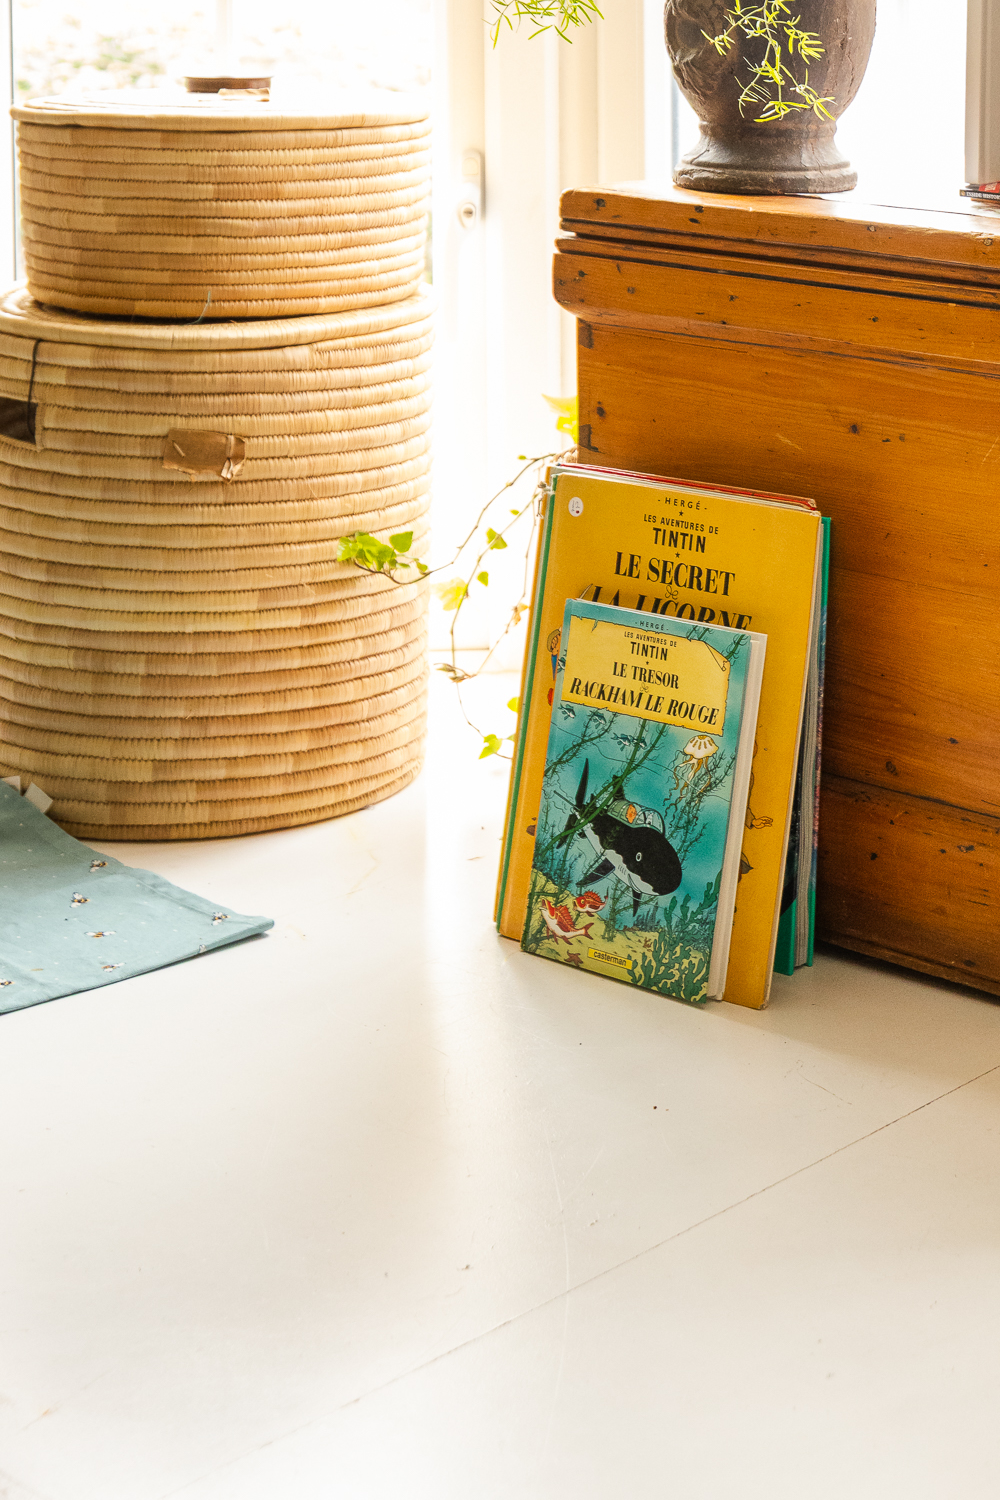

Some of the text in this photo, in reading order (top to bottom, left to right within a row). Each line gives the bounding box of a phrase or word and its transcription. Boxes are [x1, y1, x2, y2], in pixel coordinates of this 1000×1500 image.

[664, 497, 701, 510] HERGÉ
[643, 513, 719, 535] LES AVENTURES DE
[652, 526, 707, 554] TINTIN
[613, 550, 736, 597] LE SECRET
[639, 620, 665, 631] HERGÉ
[624, 630, 677, 648] LES AVENTURES DE
[630, 641, 669, 661] TINTIN
[612, 661, 680, 689] LE TRESOR
[569, 677, 720, 726] RACKHAM LE ROUGE
[593, 951, 627, 967] casterman
